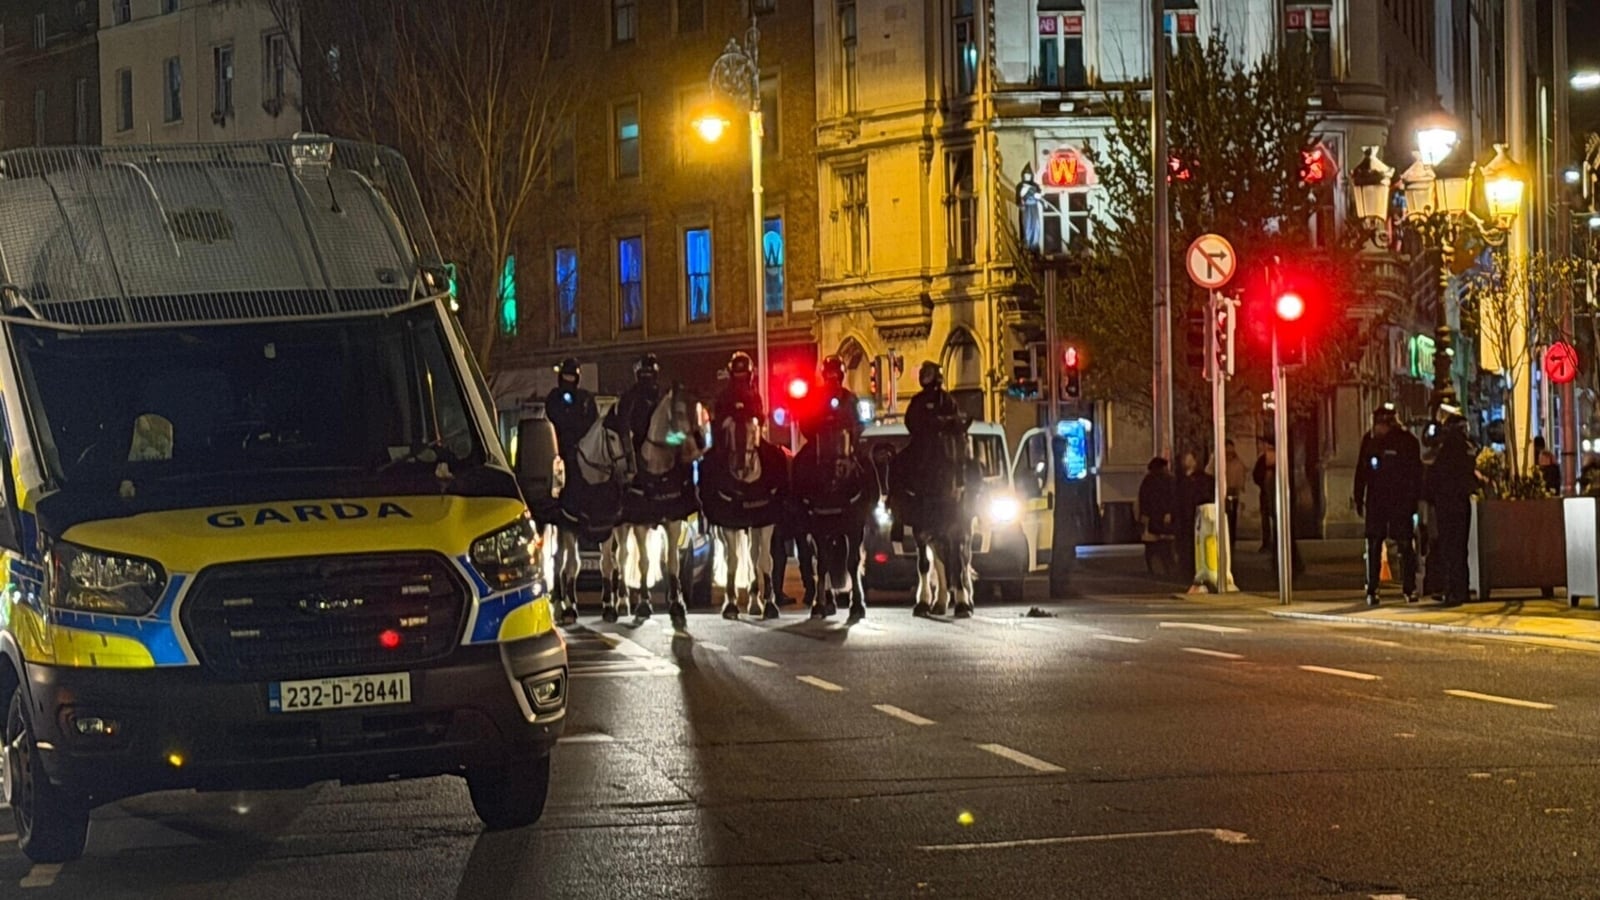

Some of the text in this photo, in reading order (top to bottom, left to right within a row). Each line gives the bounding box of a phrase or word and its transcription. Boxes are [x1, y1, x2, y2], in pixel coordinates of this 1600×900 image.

[1050, 157, 1077, 184] W
[206, 502, 414, 528] GARDA
[287, 679, 404, 708] 232-D-28441
